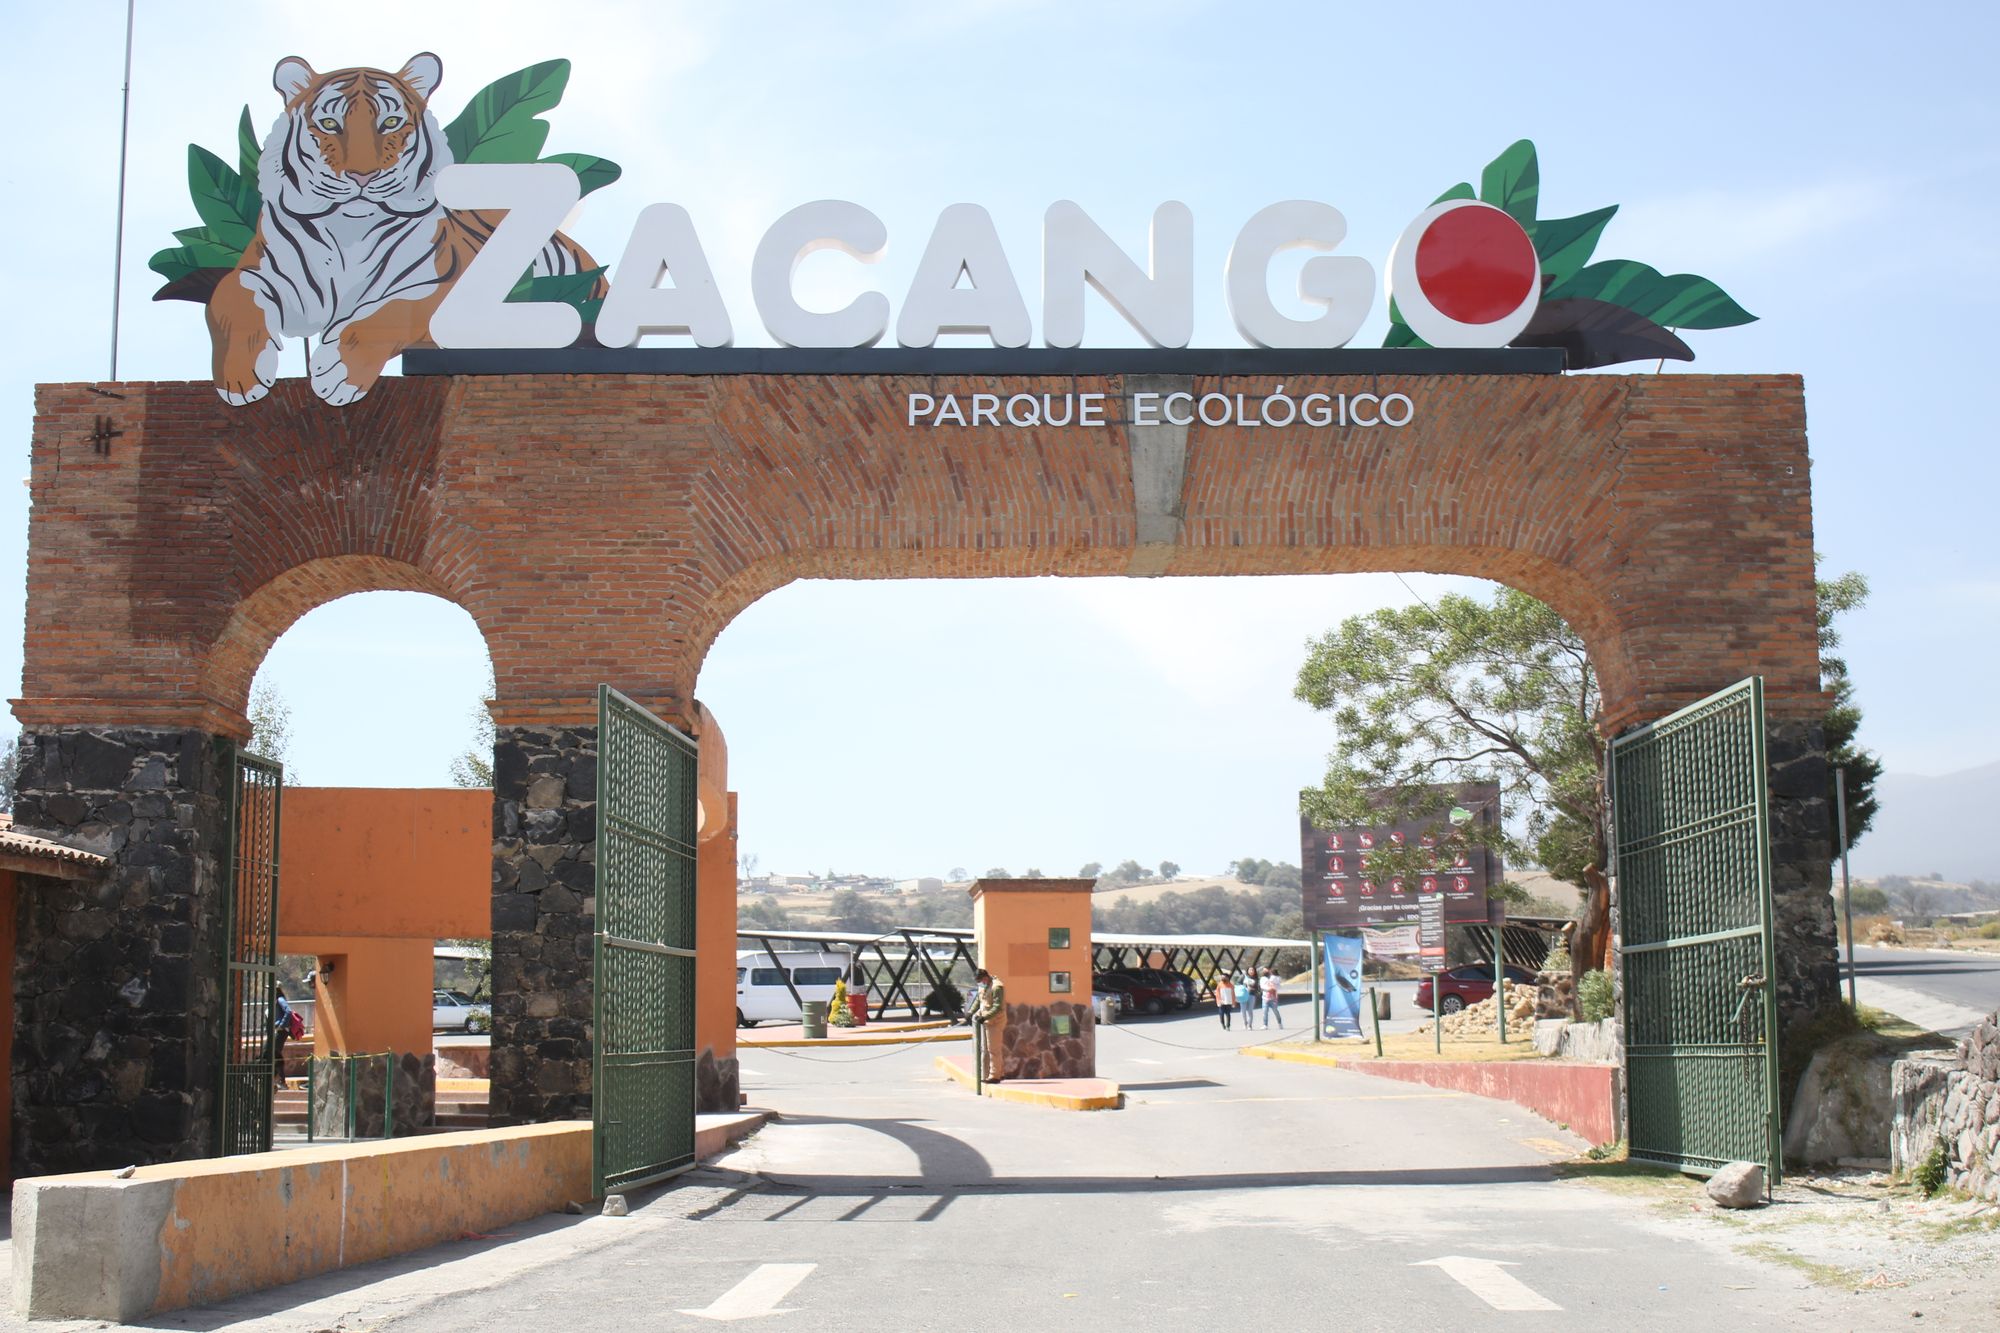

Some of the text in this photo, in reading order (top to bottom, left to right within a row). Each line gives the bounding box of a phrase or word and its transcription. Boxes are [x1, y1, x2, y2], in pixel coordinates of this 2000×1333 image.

[429, 163, 1541, 349] ZACANGO
[908, 385, 1415, 427] PARQUE ECOLÓGICO
